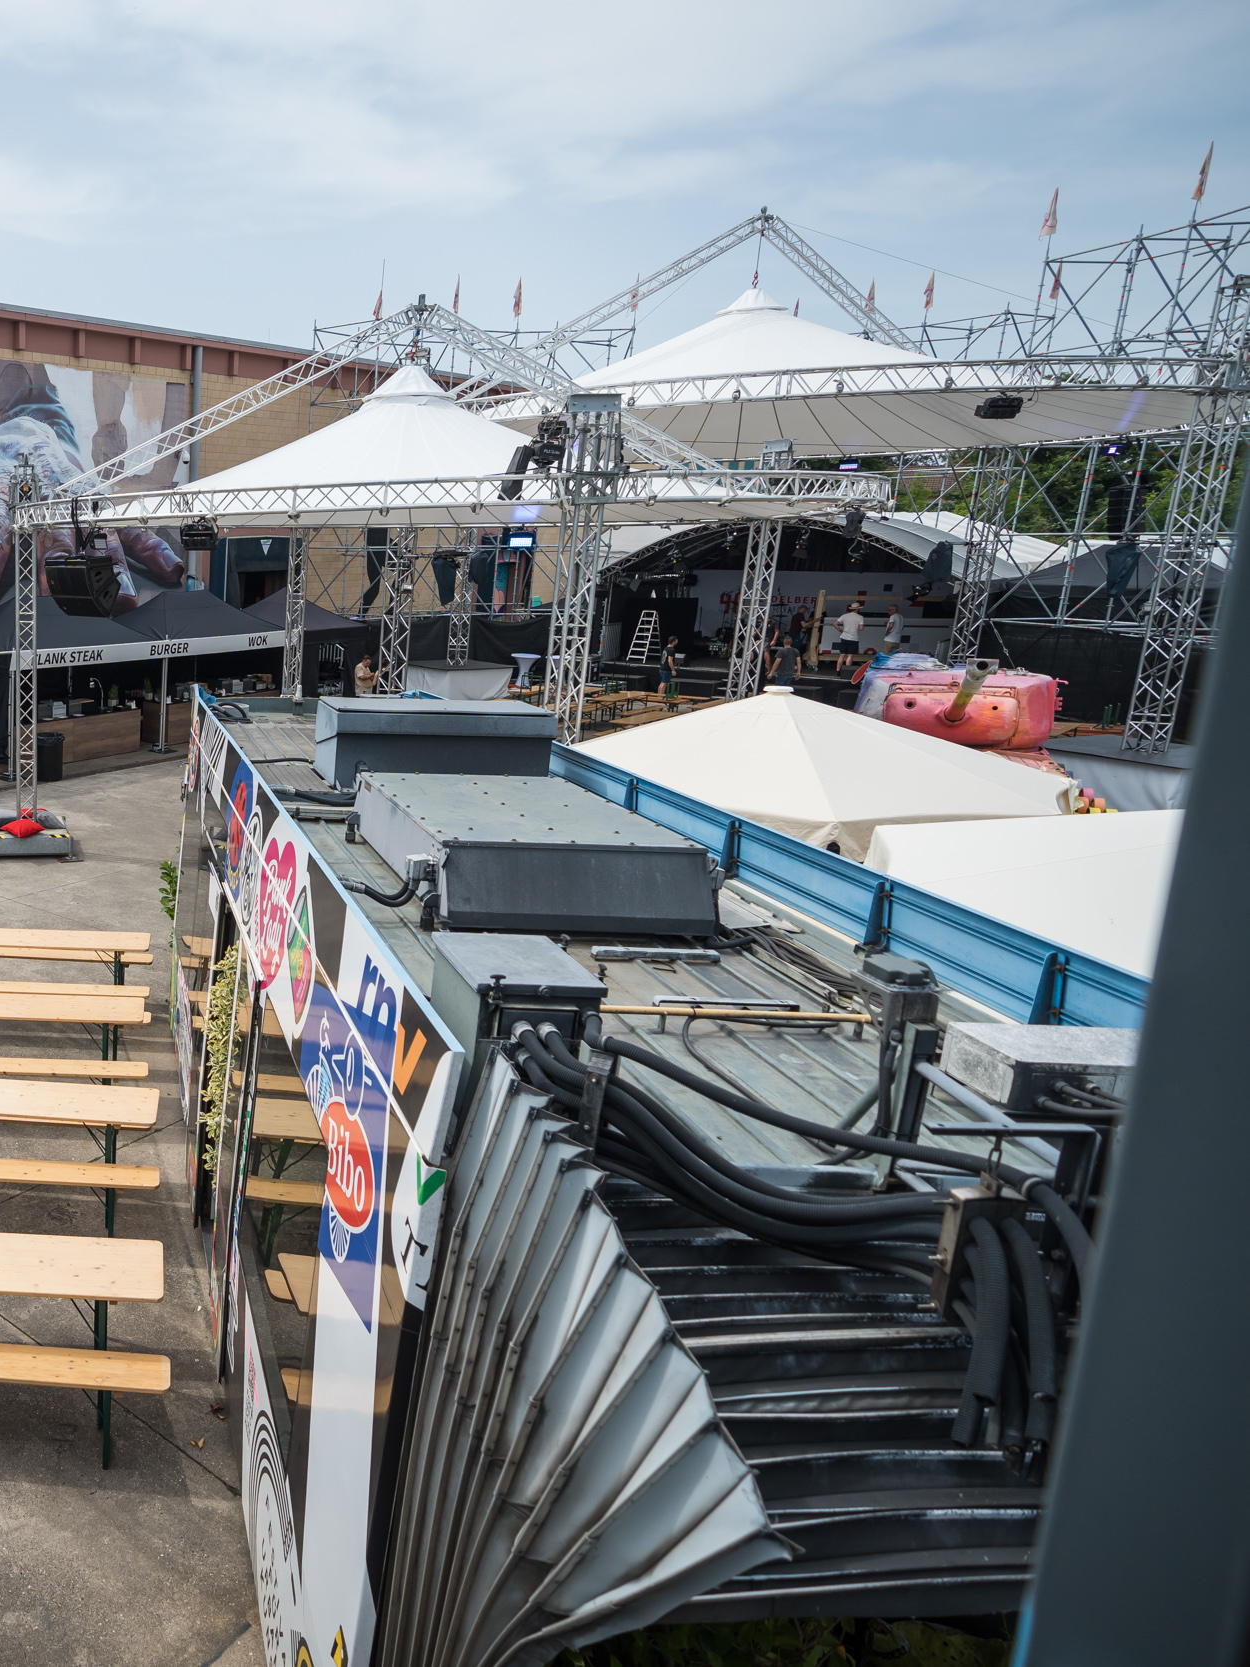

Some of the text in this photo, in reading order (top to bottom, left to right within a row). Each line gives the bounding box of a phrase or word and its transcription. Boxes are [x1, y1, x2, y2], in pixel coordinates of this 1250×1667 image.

[248, 634, 268, 648] WOK
[149, 642, 189, 656] BURGER
[69, 649, 104, 664] STEAK
[327, 1115, 366, 1213] Bibo
